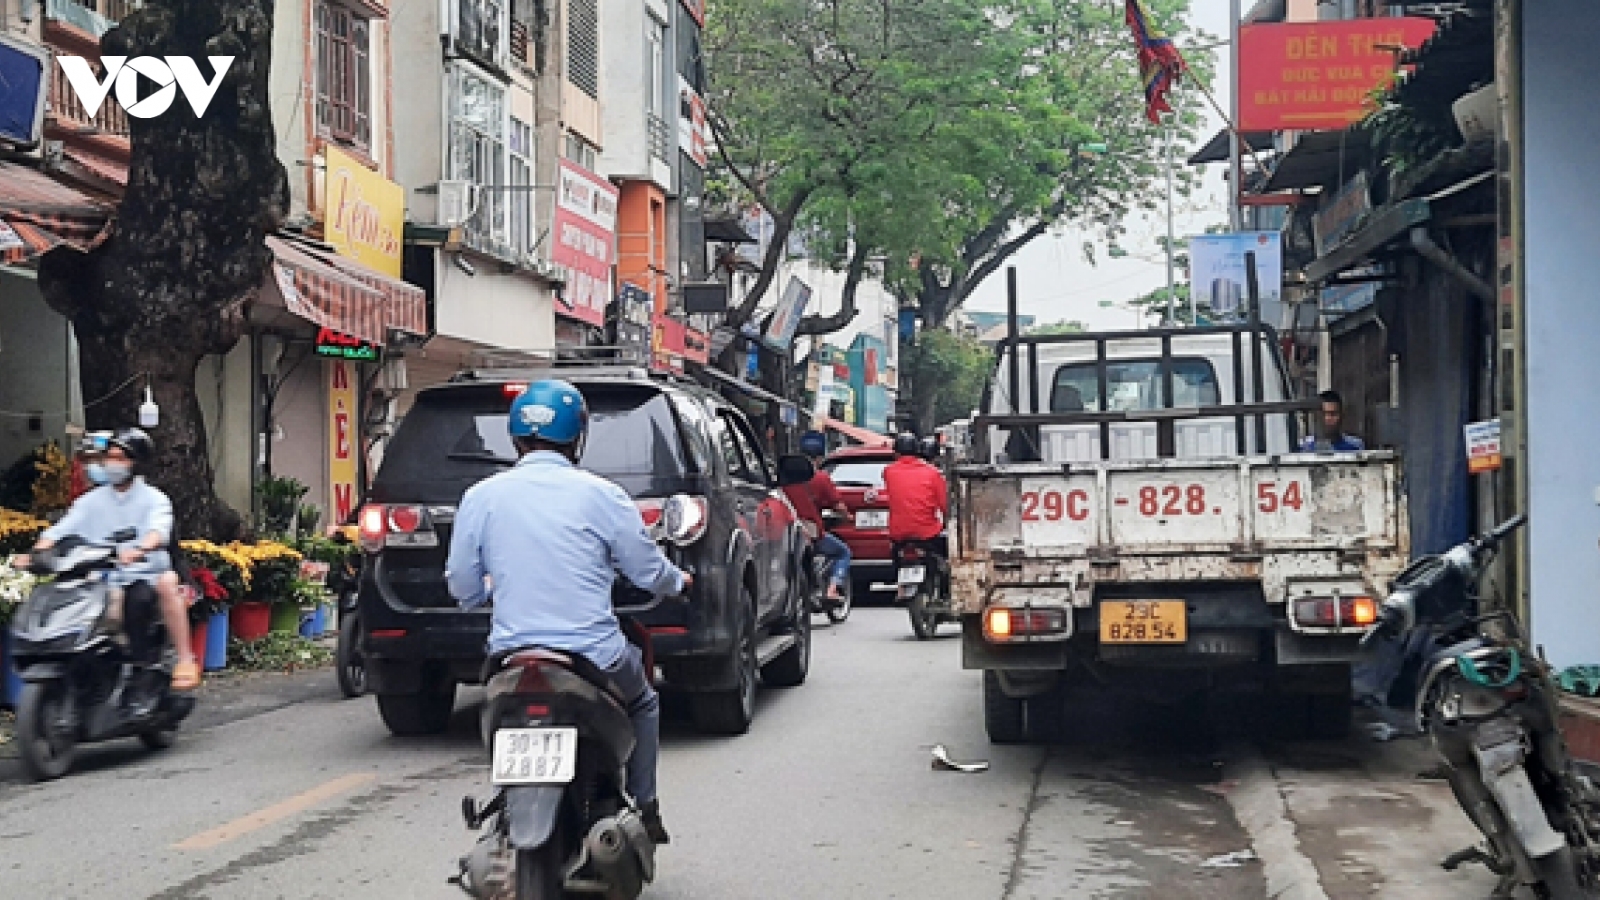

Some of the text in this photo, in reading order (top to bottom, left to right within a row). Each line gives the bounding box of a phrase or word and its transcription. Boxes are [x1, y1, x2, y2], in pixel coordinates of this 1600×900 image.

[1021, 488, 1089, 521] 29C
[1257, 480, 1303, 513] 54
[1124, 602, 1161, 620] 29C
[1109, 623, 1177, 639] 828.54
